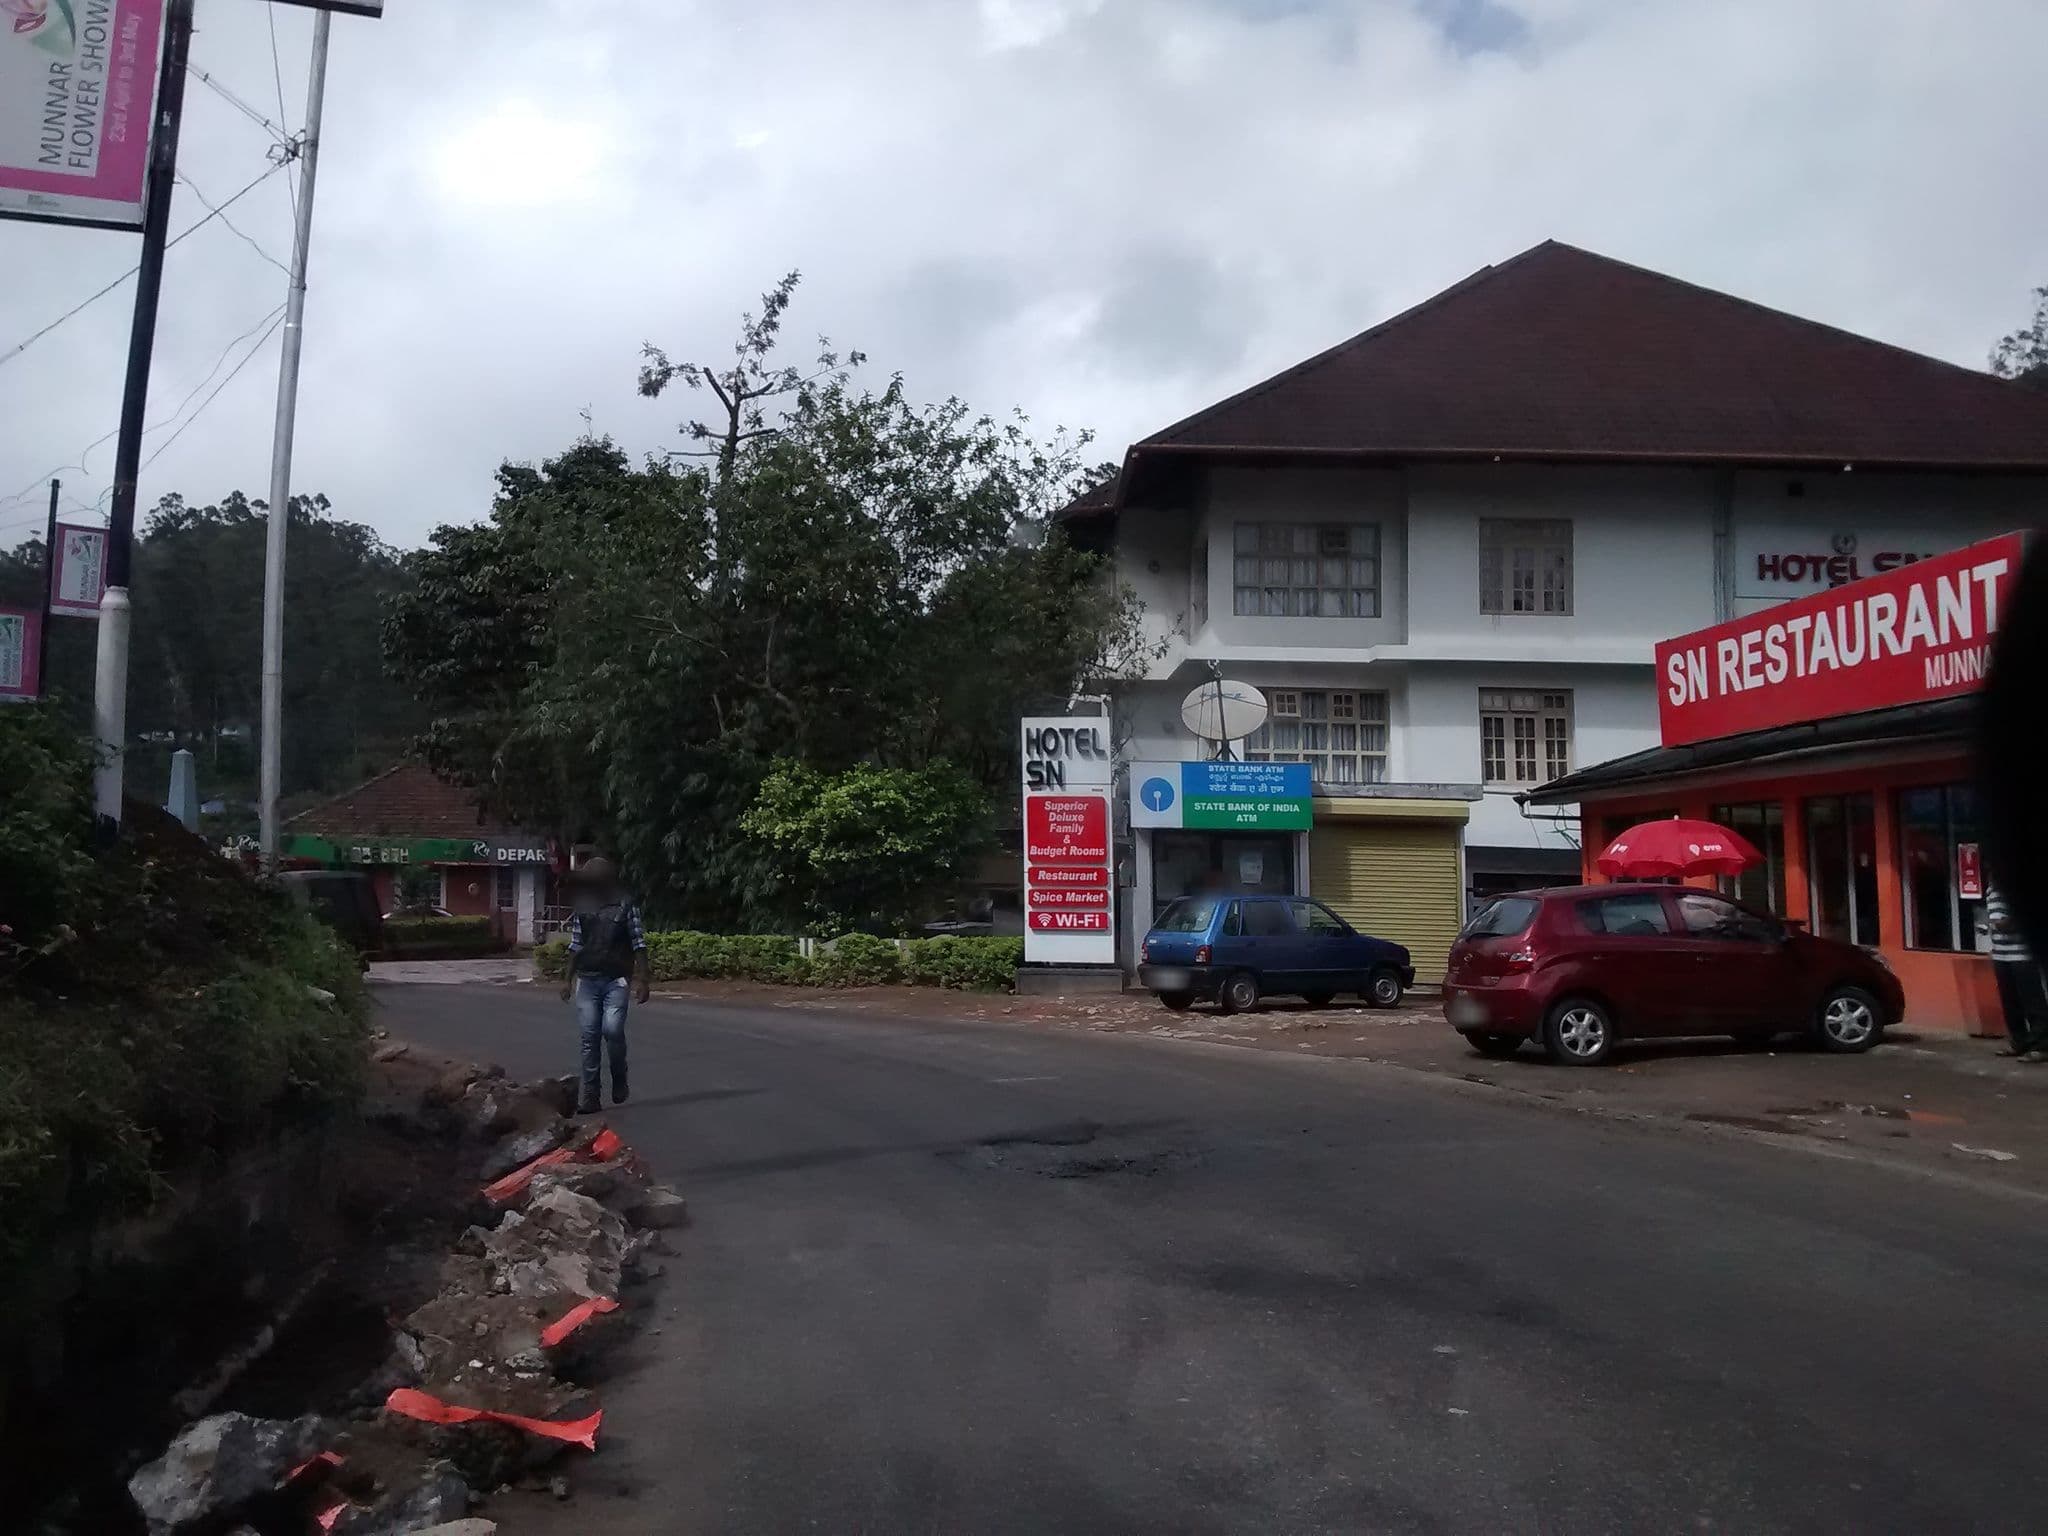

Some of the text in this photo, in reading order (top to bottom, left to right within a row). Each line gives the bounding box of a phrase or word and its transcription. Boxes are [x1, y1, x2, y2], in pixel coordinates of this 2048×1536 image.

[68, 0, 110, 168] FLOWER SHOW
[38, 61, 73, 165] MUNNAR
[1758, 553, 1865, 583] HOTEL
[1667, 558, 2008, 707] SN RESTAURANT
[1026, 727, 1108, 760] HOTEL
[1238, 765, 1263, 773] BANK
[1026, 760, 1066, 791] SN
[1044, 801, 1089, 812] Superior
[1194, 802, 1300, 812] STATE BANK OF INDIA
[1049, 812, 1085, 822] Deluxe
[1236, 814, 1258, 822] ATM
[1049, 823, 1085, 834] Family
[1063, 834, 1071, 844] &
[1030, 845, 1105, 858] Budget Rooms
[1038, 870, 1098, 881] Restaurant
[1033, 891, 1104, 903] Spice Market
[1055, 913, 1100, 927] Wi-Fi
